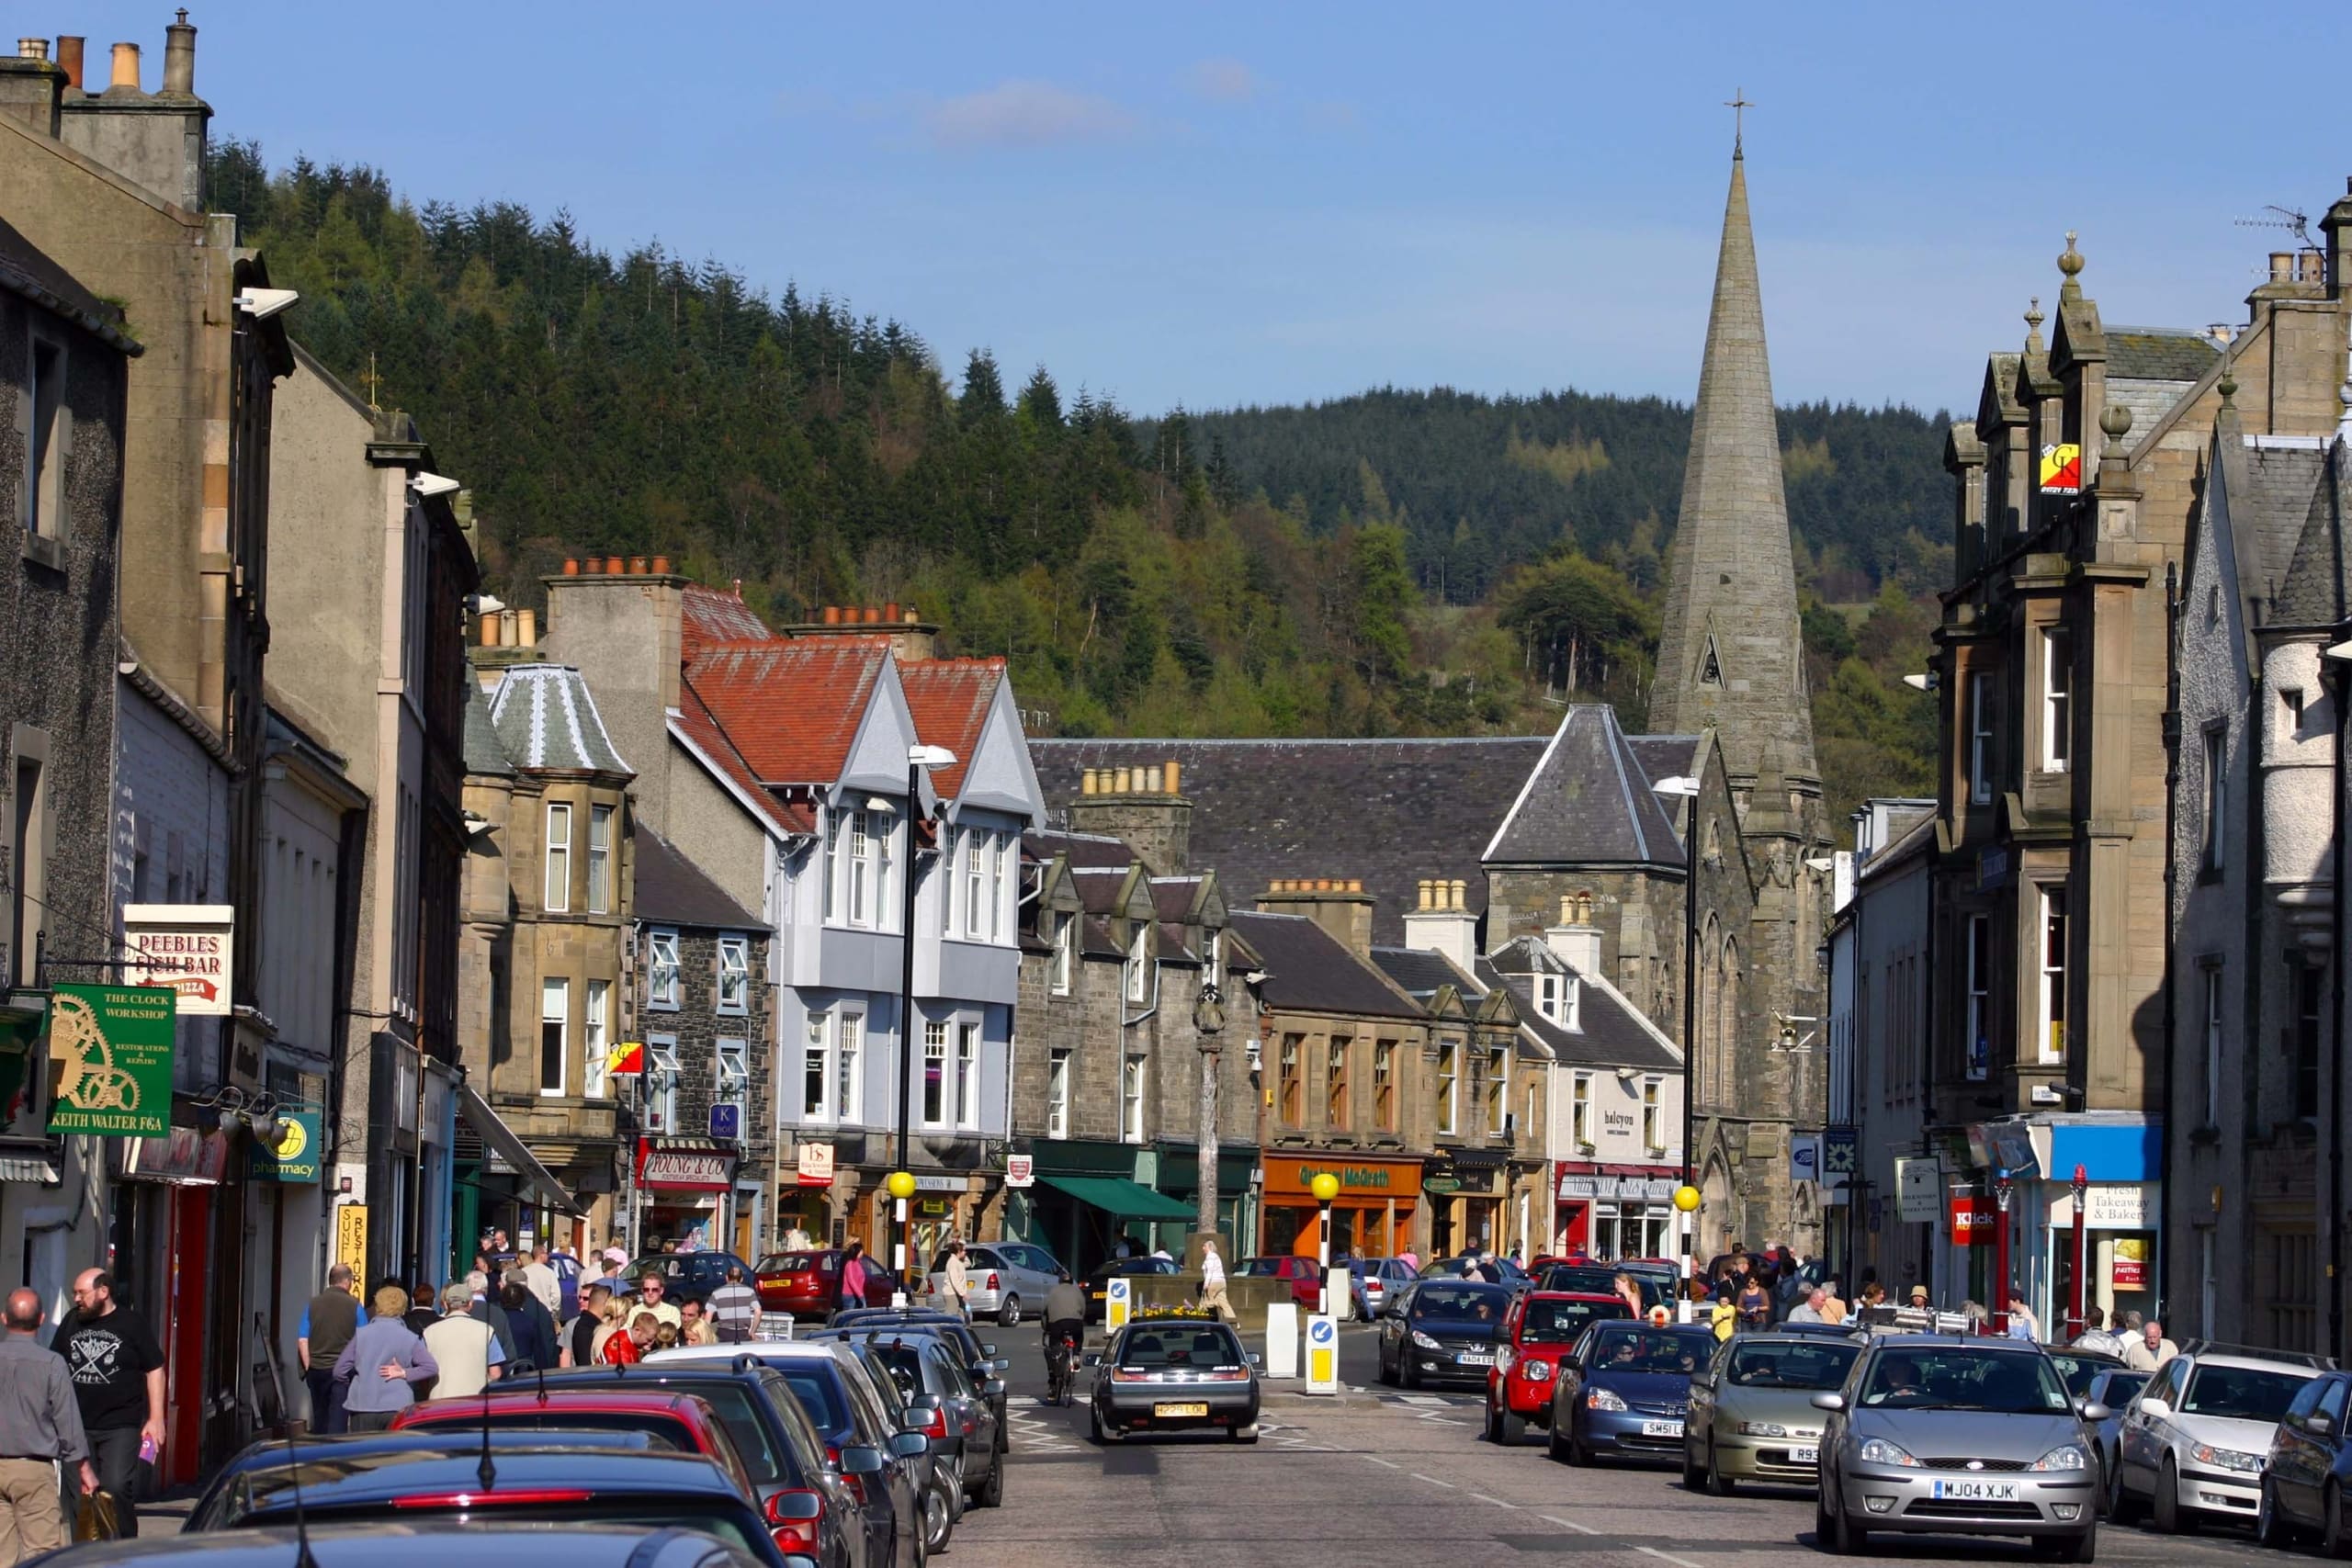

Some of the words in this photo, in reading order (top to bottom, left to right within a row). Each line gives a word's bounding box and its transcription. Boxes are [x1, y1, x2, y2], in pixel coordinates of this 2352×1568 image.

[139, 935, 220, 955] PEEBLES
[184, 957, 221, 976] BAR
[105, 993, 127, 1005] THE
[130, 995, 169, 1006] CLOCK
[106, 1008, 167, 1020] WORKSHOP
[115, 1043, 169, 1053] RESTORATIONS
[126, 1057, 157, 1066] REPAIRS
[51, 1112, 88, 1128] KEITH
[89, 1114, 137, 1130] WALTER
[140, 1116, 162, 1131] FGA
[720, 1108, 730, 1121] K
[1604, 1110, 1634, 1129] halcyon
[253, 1162, 314, 1179] pharmacy
[652, 1155, 691, 1174] YOUNG
[695, 1156, 705, 1174] &
[707, 1158, 725, 1176] CO
[1344, 1167, 1388, 1188] McGrath
[2107, 1184, 2138, 1195] Fresh
[2094, 1196, 2150, 1210] Takeaway
[1955, 1212, 1994, 1224] Klick
[2094, 1209, 2104, 1220] &
[2109, 1208, 2149, 1221] Bakery
[1944, 1482, 1981, 1498] MJ04
[1986, 1484, 2014, 1499] XJK
